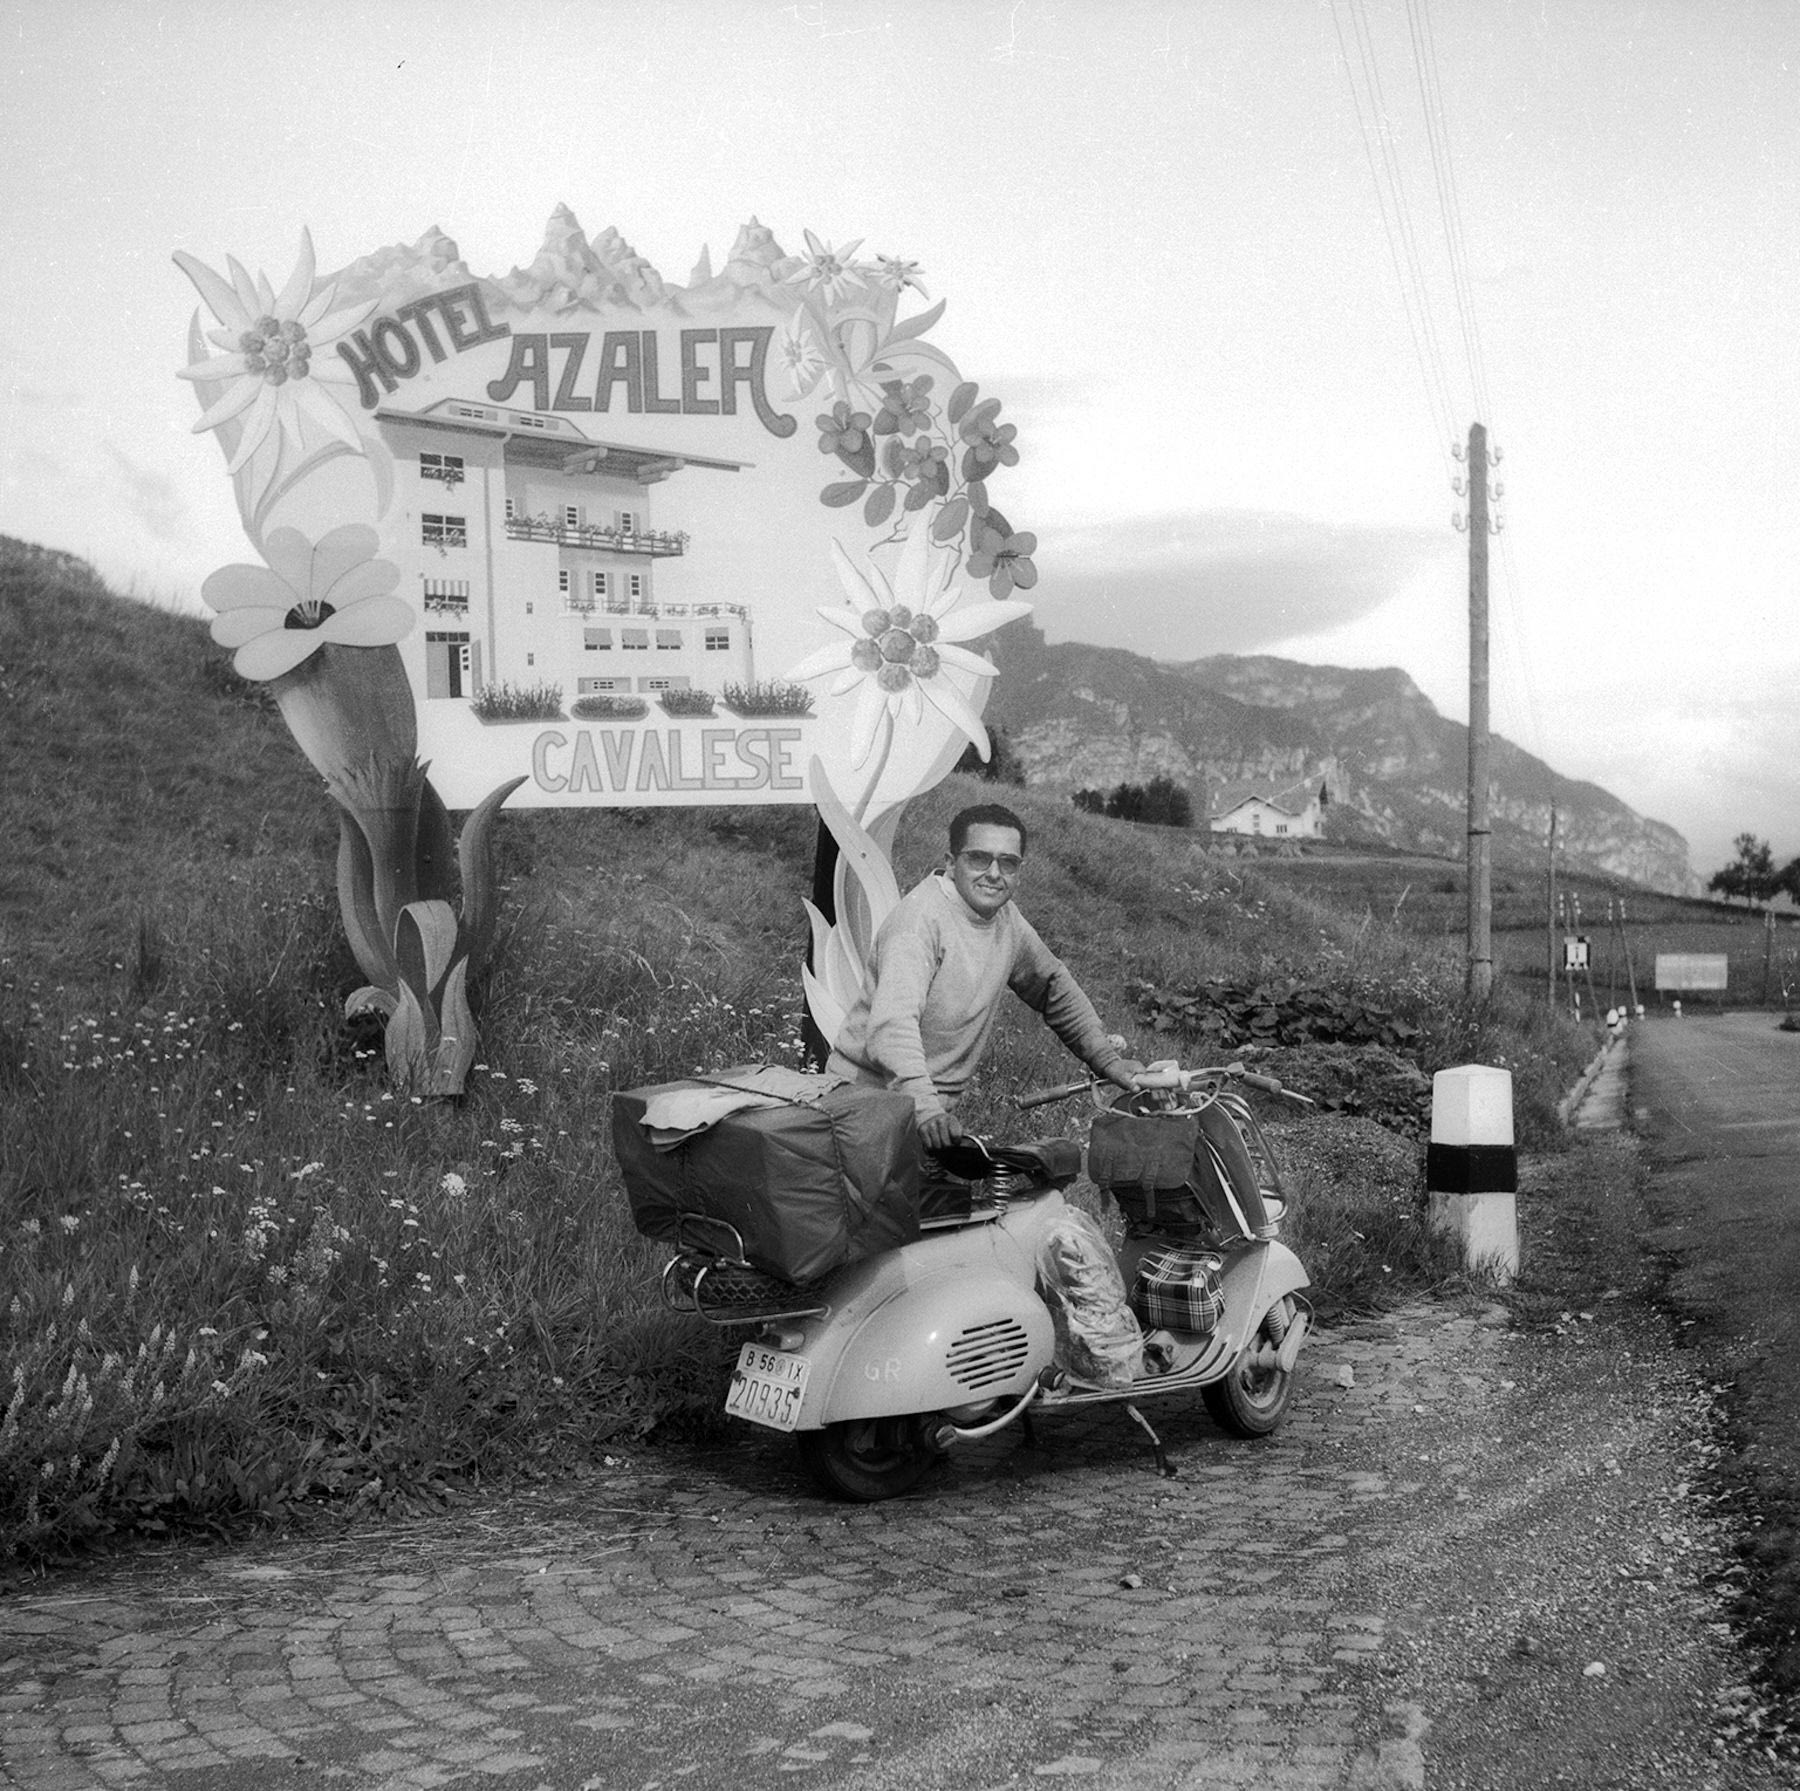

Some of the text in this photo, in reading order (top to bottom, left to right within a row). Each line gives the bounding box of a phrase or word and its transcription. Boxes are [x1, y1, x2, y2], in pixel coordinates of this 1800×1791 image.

[336, 283, 797, 438] HOTEL AZALEA
[532, 728, 803, 793] CAVALESE
[759, 1353, 776, 1372] 56
[864, 1357, 902, 1382] GR
